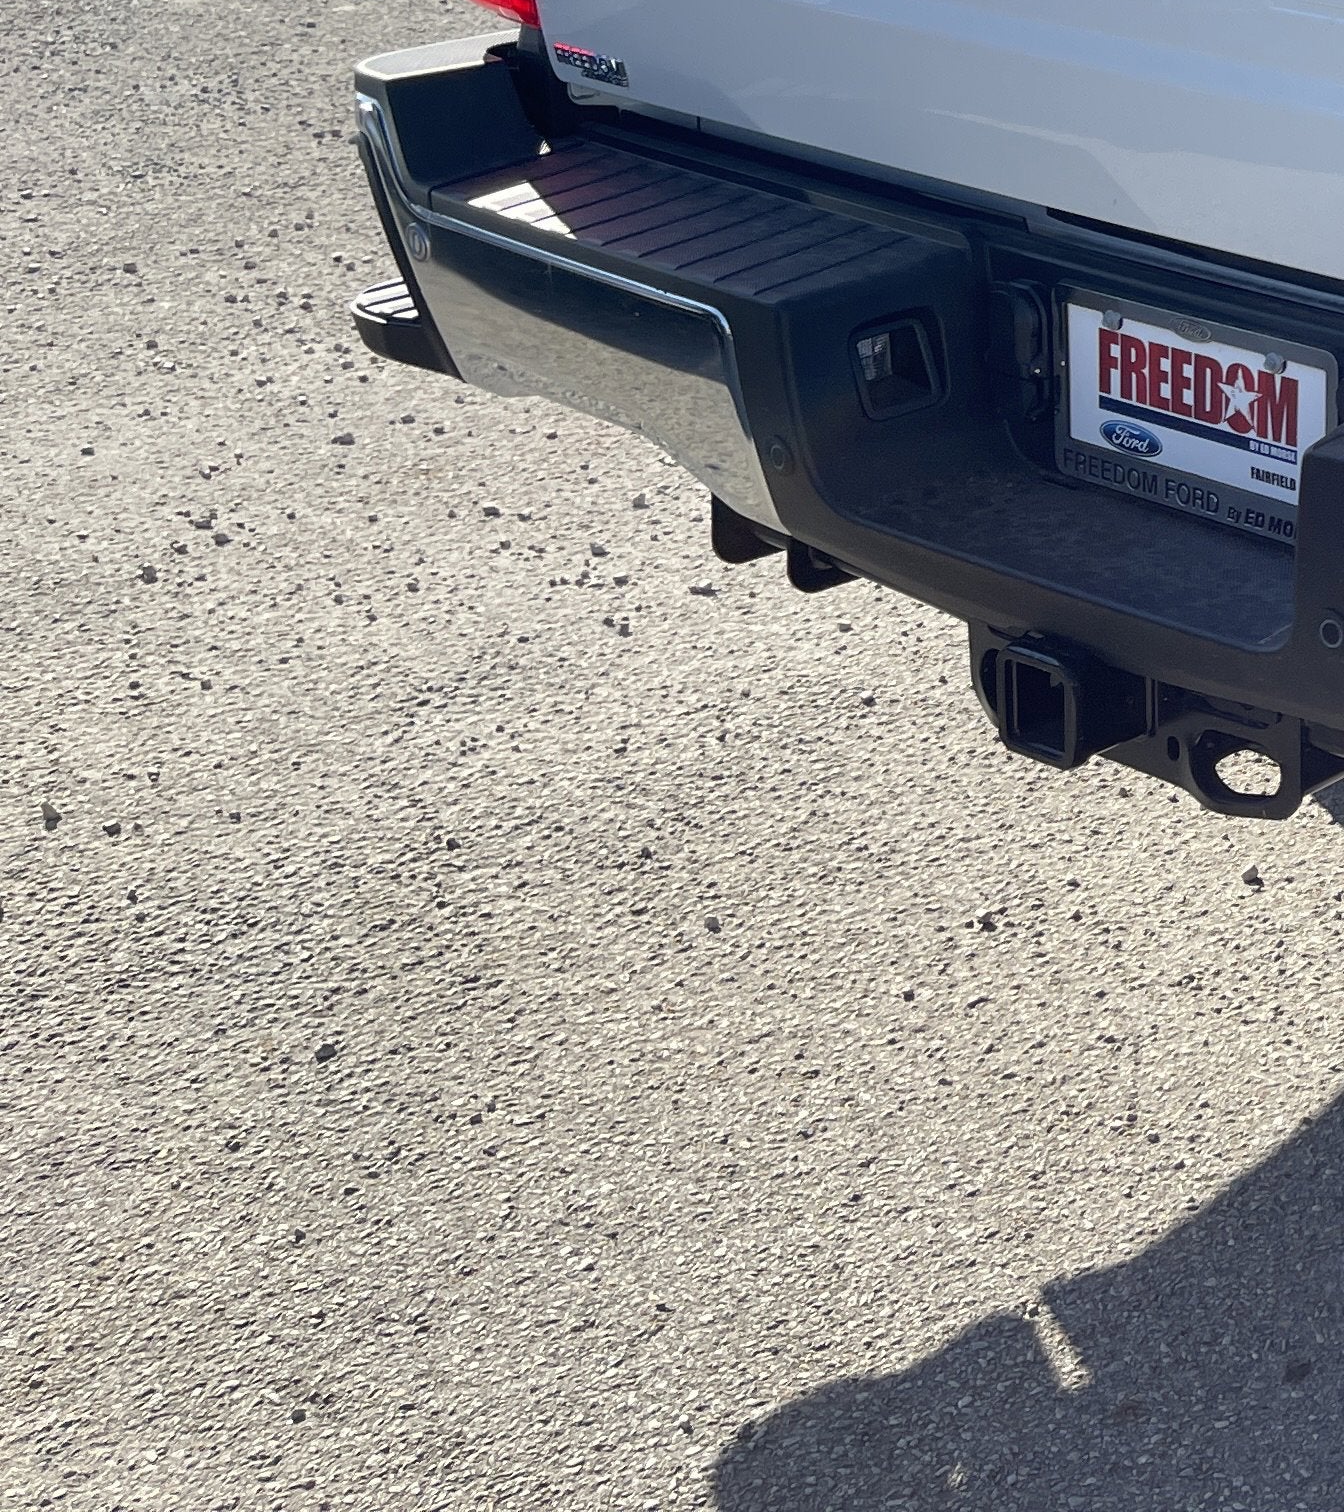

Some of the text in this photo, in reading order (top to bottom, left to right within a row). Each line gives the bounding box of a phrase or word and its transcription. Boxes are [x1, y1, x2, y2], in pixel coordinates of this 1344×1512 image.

[1098, 327, 1299, 448] FREEDOM
[1111, 423, 1151, 454] Ford
[1062, 448, 1296, 539] FREEDOM FORD By ED MO
[1250, 466, 1297, 491] FAIRFIELD
